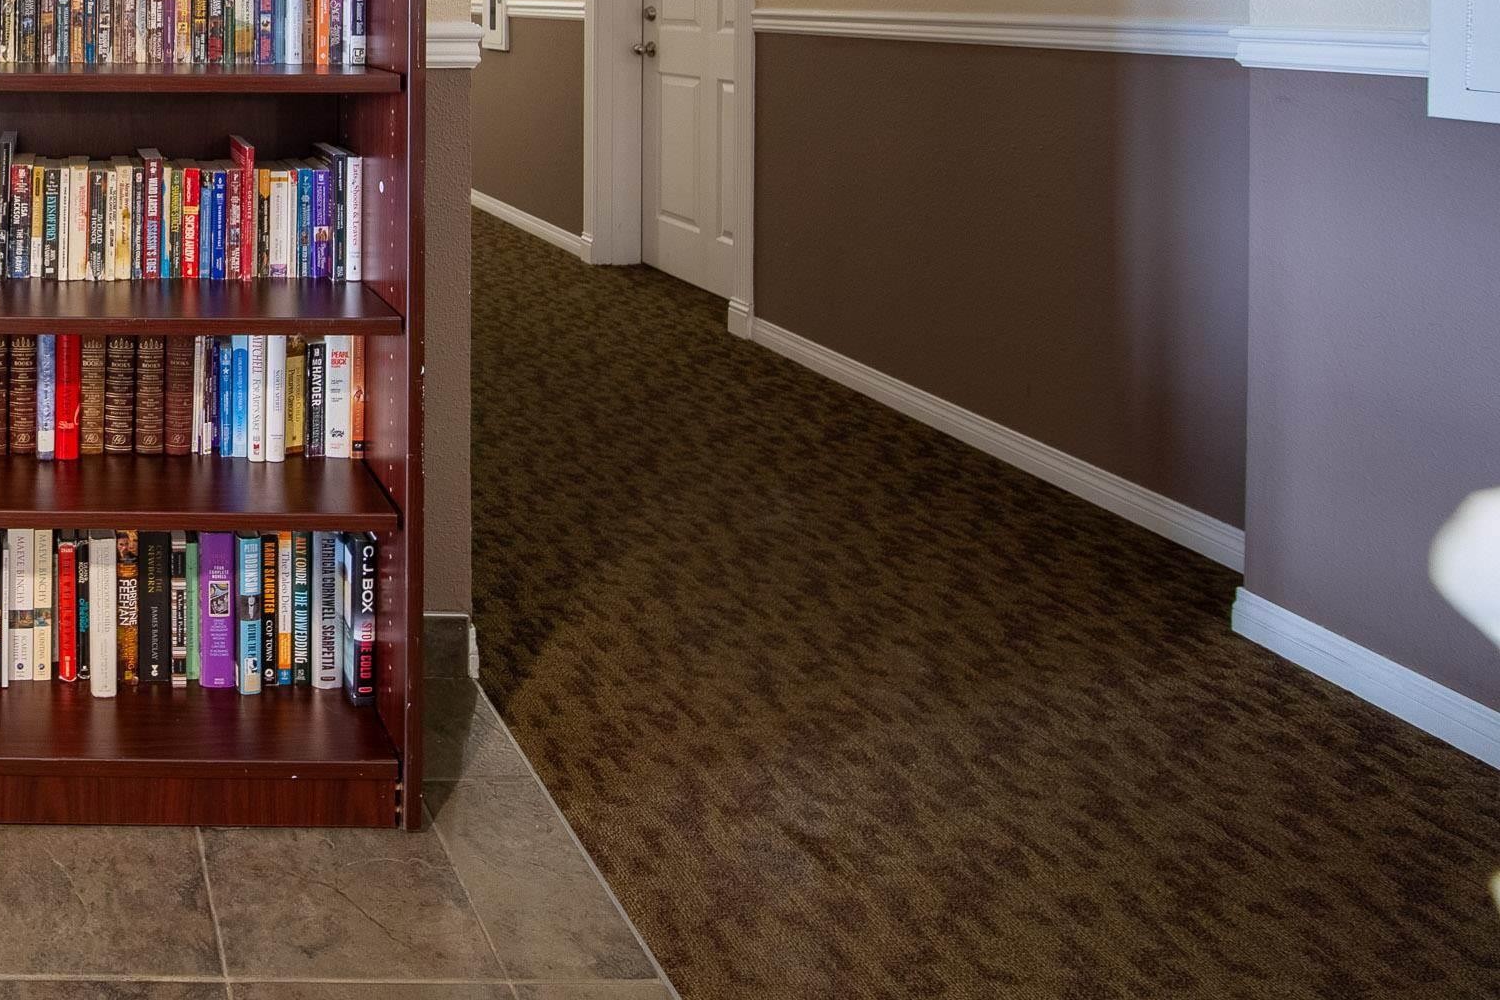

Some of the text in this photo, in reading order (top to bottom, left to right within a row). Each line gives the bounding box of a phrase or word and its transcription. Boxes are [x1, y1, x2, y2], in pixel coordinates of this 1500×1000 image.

[13, 194, 21, 224] JACKSON
[148, 177, 158, 194] WARD
[148, 194, 158, 216] LARSEN
[311, 366, 322, 407] HAYDER
[264, 542, 275, 566] KARIN
[119, 579, 129, 626] FEEHAN
[129, 578, 137, 625] CHRISTINE
[264, 568, 275, 613] SLAUGHTER
[281, 551, 290, 613] The Paleo Diet
[295, 537, 307, 664] ALLY CONDIE THE UNWEDDING
[362, 545, 373, 614] C. J. BOX
[321, 538, 336, 670] PATRICIA CORNWELL SCARPETTA
[360, 622, 372, 679] STONE COLD
